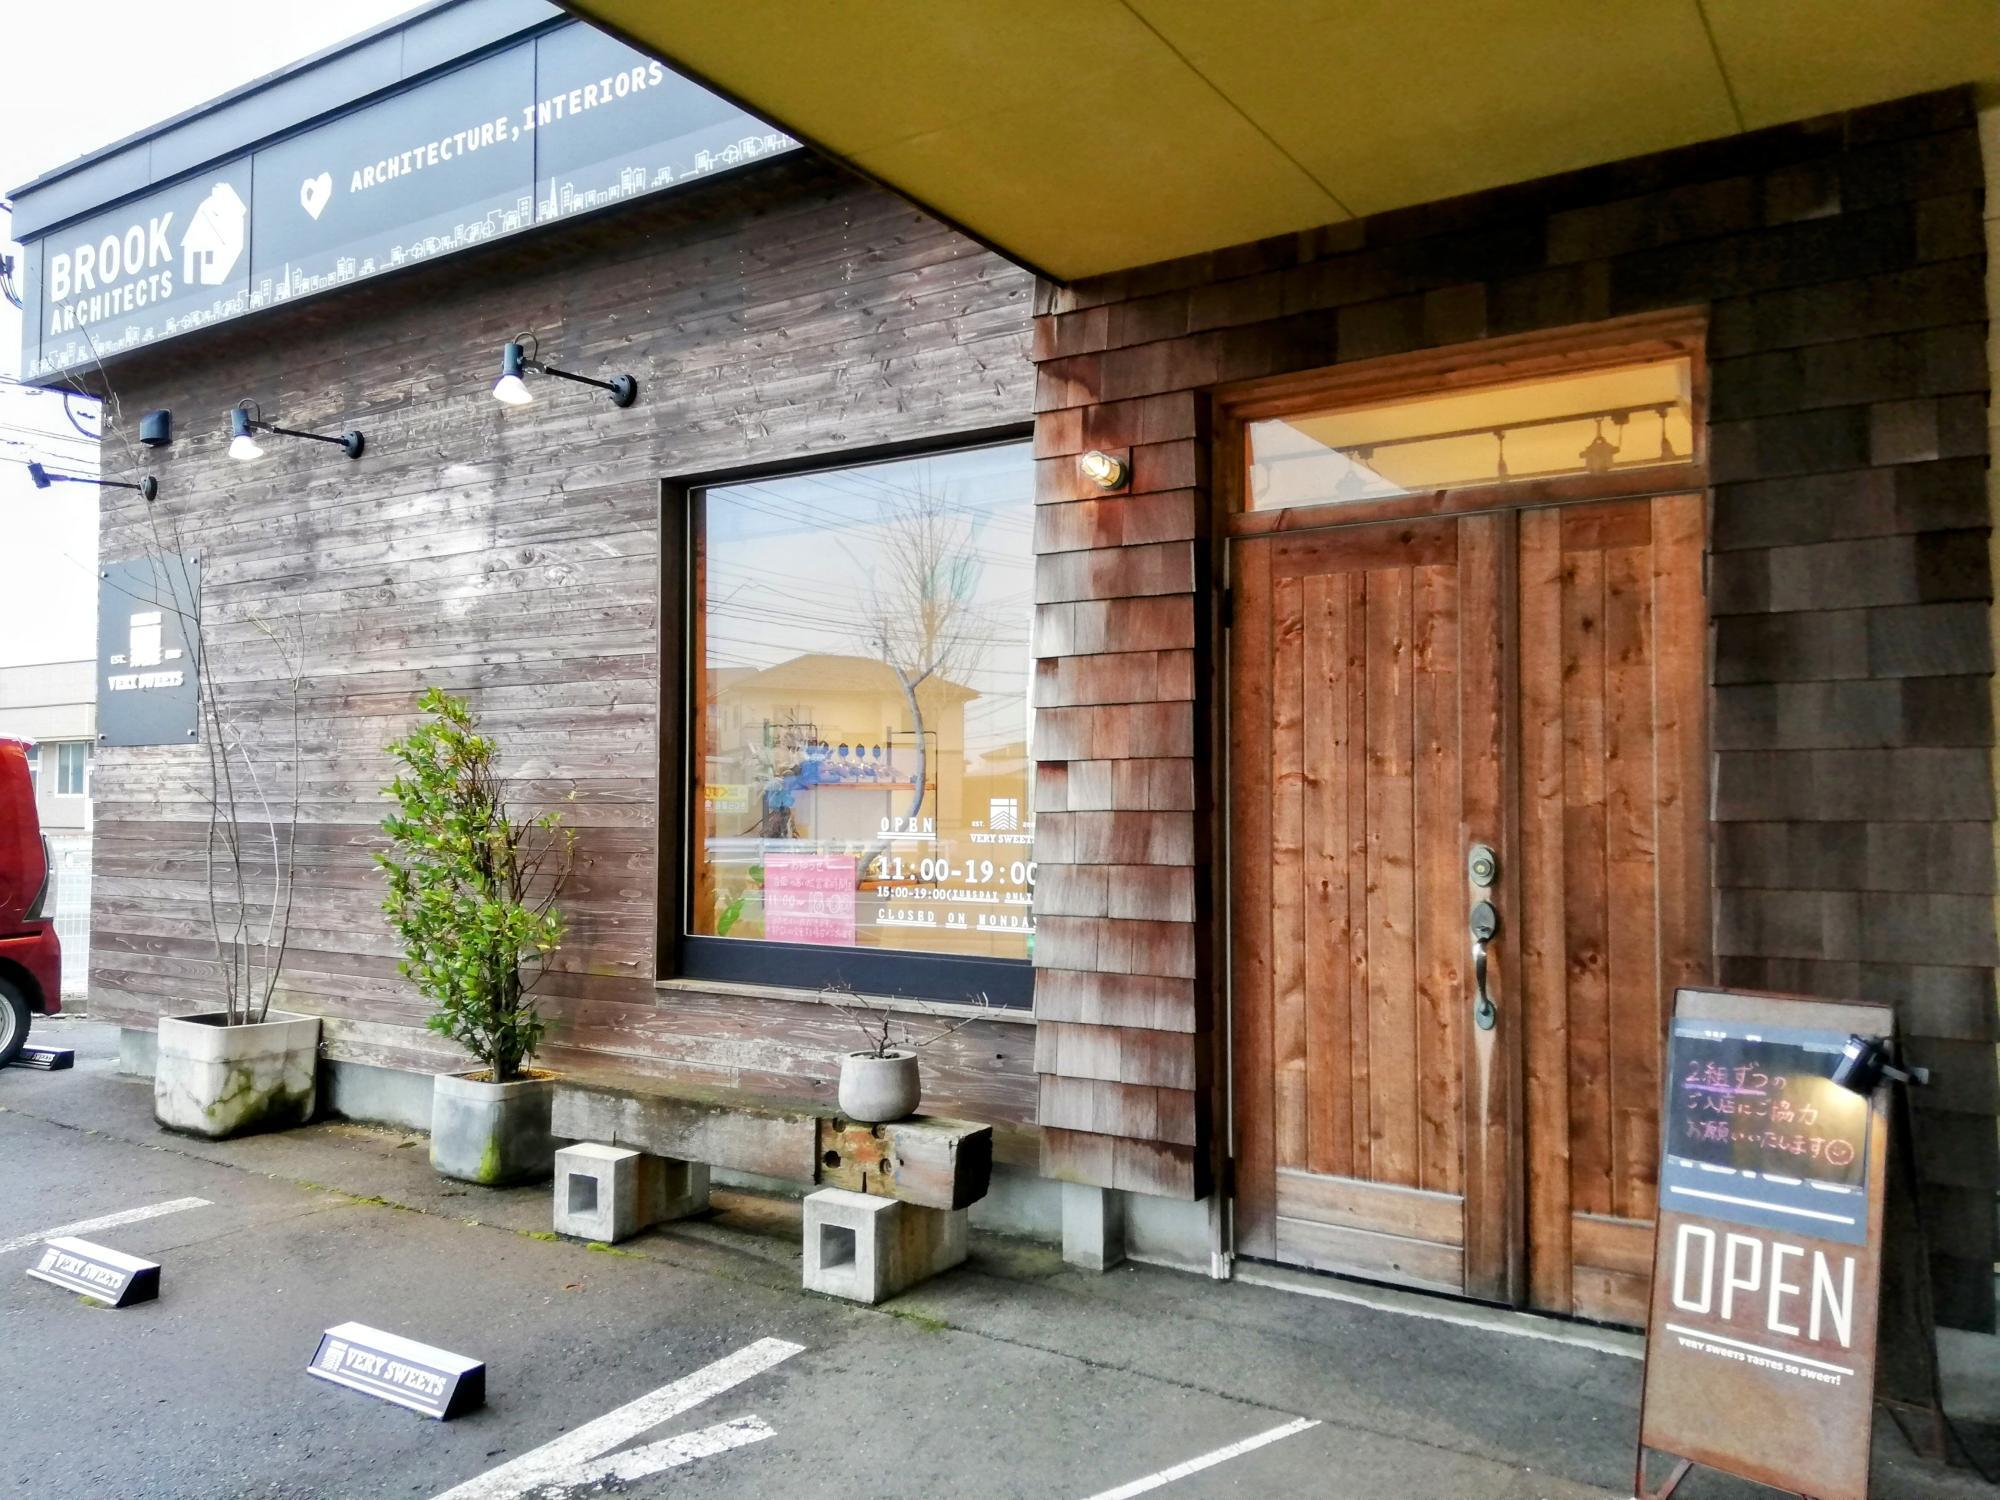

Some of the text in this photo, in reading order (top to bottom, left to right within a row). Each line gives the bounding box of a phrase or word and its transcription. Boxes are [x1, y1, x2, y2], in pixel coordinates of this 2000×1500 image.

[51, 211, 174, 303] BROOK
[50, 270, 173, 336] ARCHITECTS
[880, 816, 933, 833] OPEN
[970, 833, 996, 844] VERY
[878, 908, 935, 922] CLOSED
[947, 912, 966, 924] ON
[1687, 1093, 1818, 1125] ご入店にご協力
[1686, 1120, 1826, 1158] お願いいたします
[1673, 1223, 1855, 1348] OPEN
[345, 1347, 447, 1397] VERY SWEETS
